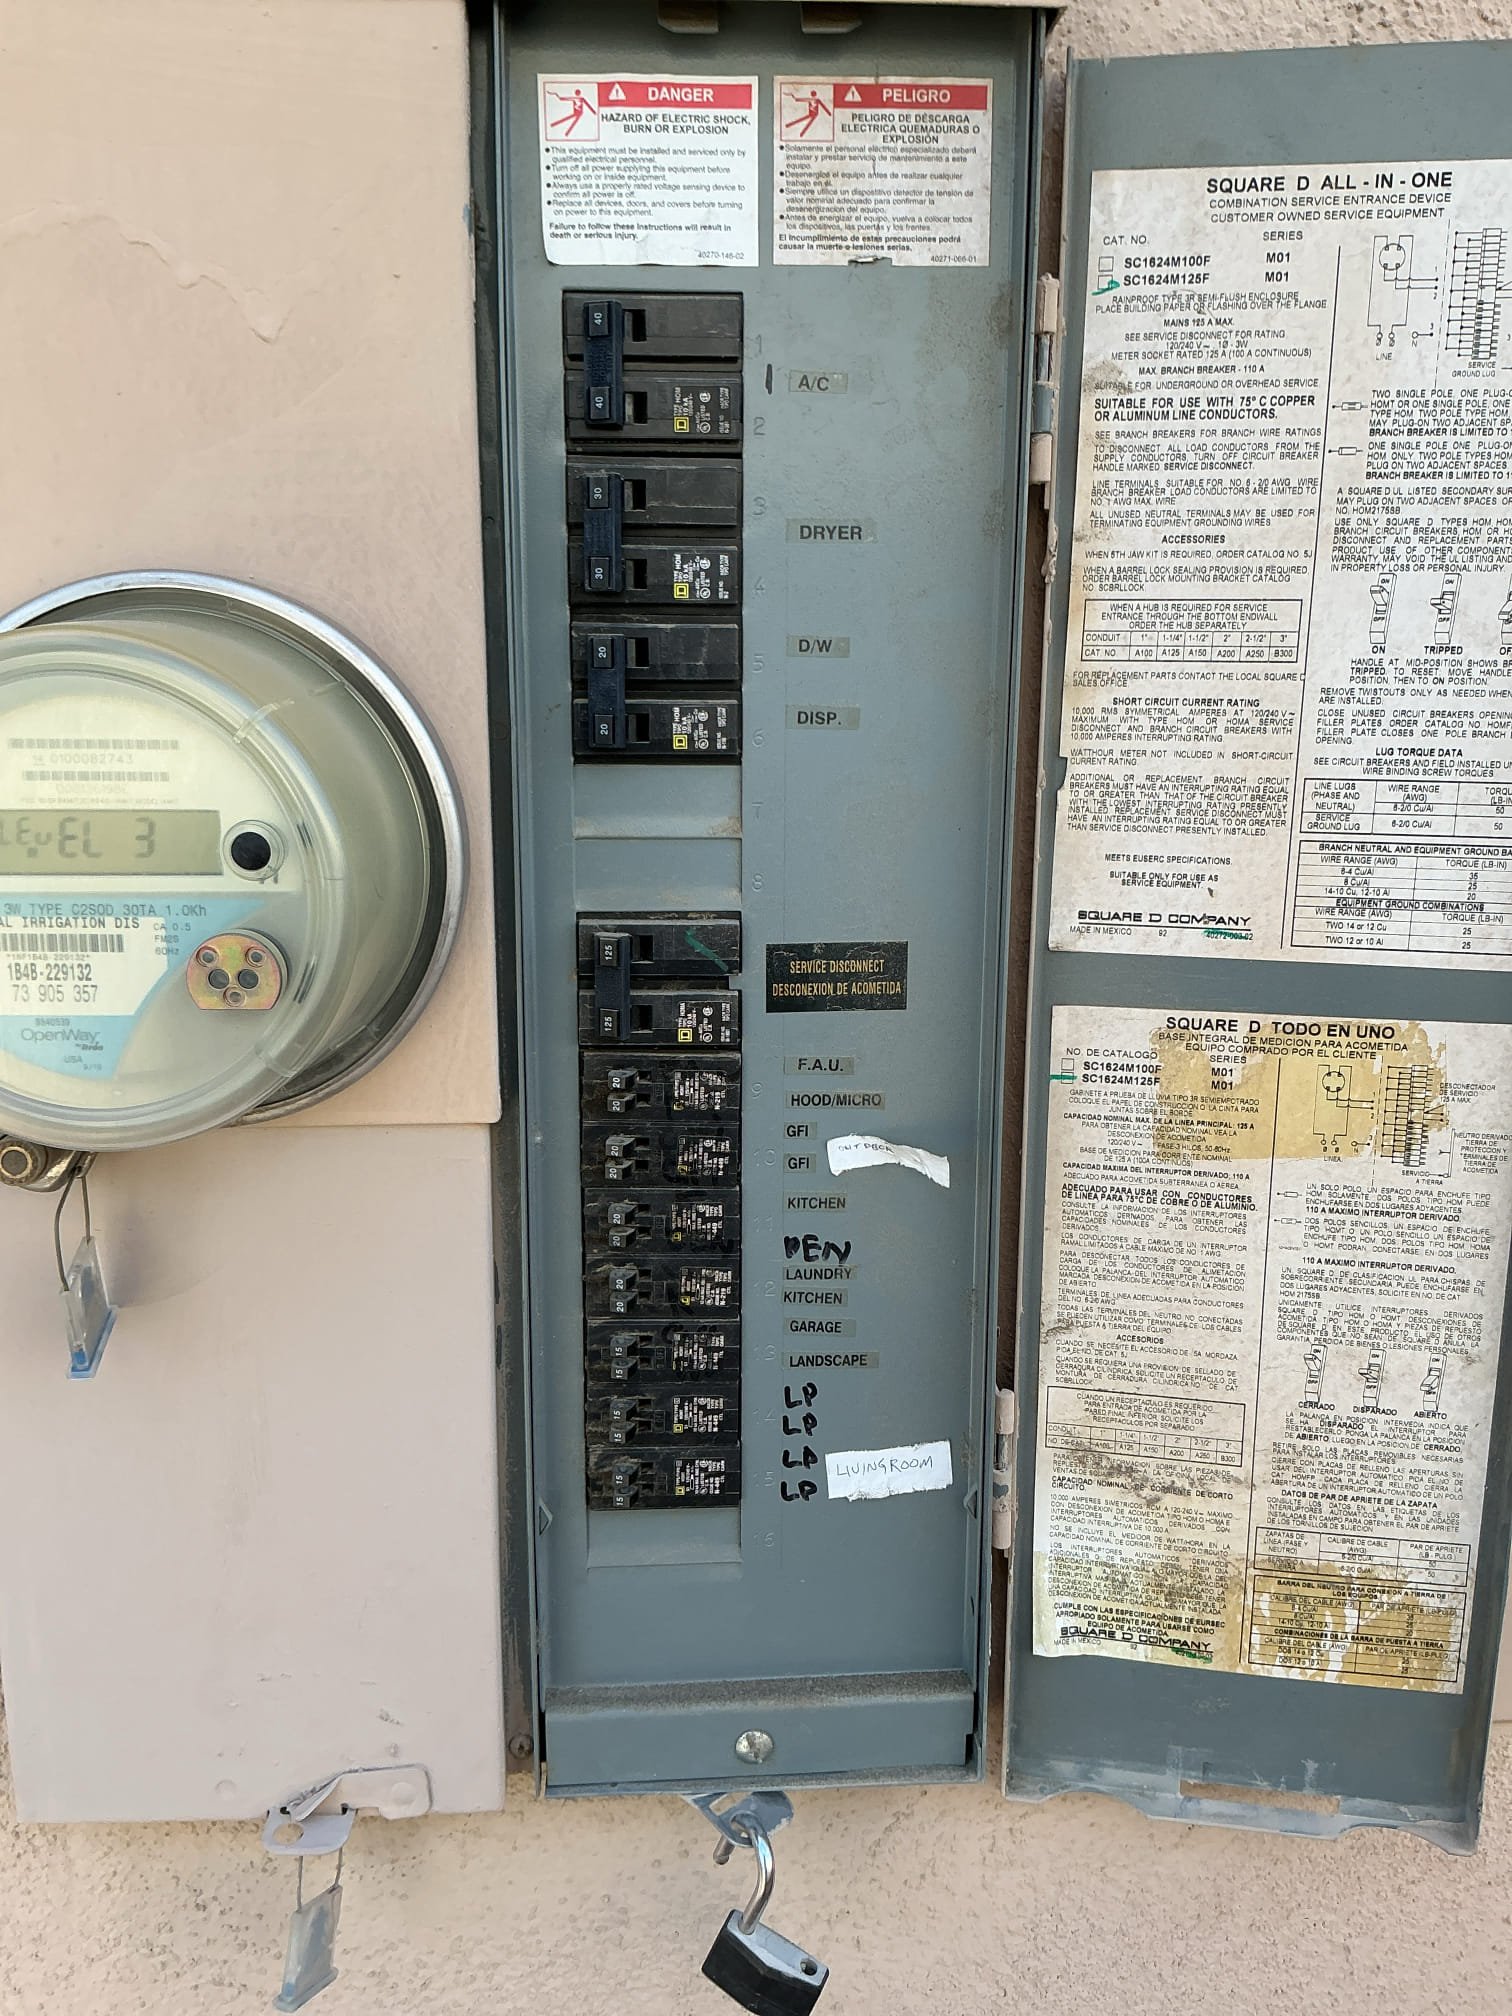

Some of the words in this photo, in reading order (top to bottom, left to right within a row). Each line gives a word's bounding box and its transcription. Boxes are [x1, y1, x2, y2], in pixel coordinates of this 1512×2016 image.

[648, 87, 713, 102] DANGER
[883, 89, 950, 102] PELIGRO
[600, 114, 642, 122] HAZARD
[645, 114, 658, 123] OF
[662, 114, 710, 123] ELECTRIC
[713, 115, 750, 125] SHOCK,
[852, 113, 895, 124] PELIGRO
[898, 113, 911, 123] DE
[624, 124, 651, 133] BURN
[655, 124, 669, 133] OR
[673, 125, 728, 134] EXPLOSION
[842, 124, 897, 135] ELECTRICA
[899, 124, 969, 135] QUEMADURAS
[973, 125, 980, 134] O
[1207, 177, 1285, 193] SQUARE
[1297, 176, 1309, 191] D
[1321, 175, 1356, 190] ALL
[1375, 173, 1393, 188] IN
[1412, 172, 1452, 188] ONE
[1210, 197, 1287, 208] COMBINATION
[1291, 196, 1340, 206] SERVICE
[1344, 194, 1405, 205] ENTRANCE
[1409, 193, 1452, 203] DEVICE
[1211, 212, 1273, 223] CUSTOMER
[1278, 211, 1320, 221] OWNED
[1324, 210, 1373, 220] SERVICE
[1377, 208, 1445, 219] EQUIPMENT
[1131, 235, 1149, 245] NO.
[1263, 231, 1303, 241] SERIES
[1125, 256, 1211, 268] SC1624M100F
[1266, 252, 1290, 263] M01
[1124, 273, 1210, 286] SC1624M125F
[1265, 271, 1288, 282] M01
[594, 312, 602, 325] 40
[796, 375, 829, 392] A/C
[595, 396, 604, 409] 40
[1095, 398, 1146, 409] SUITABLE
[1152, 397, 1173, 408] FOR
[1180, 397, 1200, 408] USE
[1207, 396, 1233, 407] WITH
[1240, 396, 1256, 407] 75°
[1259, 395, 1266, 407] C
[1270, 395, 1315, 406] COPPER
[1095, 411, 1109, 421] OR
[1112, 410, 1169, 421] ALUMINUM
[1173, 409, 1195, 420] LINE
[1199, 408, 1277, 420] CONDUCTORS.
[594, 487, 602, 500] 30
[800, 525, 862, 540] DRYER
[1162, 535, 1225, 544] ACCESSORIES
[594, 567, 603, 580] 30
[598, 646, 607, 658] 20
[799, 639, 832, 653] D/W
[1372, 645, 1385, 654] ON
[1424, 646, 1463, 655] TRIPPED
[1113, 697, 1142, 706] SHORT
[1145, 698, 1179, 706] CIRCUIT
[1182, 698, 1224, 707] CURRENT
[1227, 699, 1260, 707] RATING
[798, 711, 841, 725] DISP.
[600, 723, 609, 735] 20
[1376, 747, 1394, 756] LUG
[1397, 748, 1435, 757] TORQUE
[1438, 748, 1463, 757] DATA
[135, 816, 157, 859] 3
[4, 904, 21, 915] 3W
[29, 904, 62, 915] TYPE
[167, 904, 206, 916] 1.0Kh
[22, 917, 106, 928] IRRIGATION
[114, 918, 140, 928] DIS
[1078, 911, 1142, 923] SQUARE
[1149, 913, 1162, 923] D
[1168, 914, 1251, 926] COMPANY
[1070, 926, 1091, 934] MADE
[1103, 927, 1132, 935] MEXICO
[8, 963, 92, 981] 1B4B-229132
[790, 960, 827, 973] SERVICE
[830, 960, 884, 973] DISCONNECT
[12, 984, 29, 1002] 73
[39, 984, 64, 1002] 905
[73, 984, 98, 1002] 357
[773, 983, 833, 996] DESCONEXION
[837, 982, 848, 995] DE
[851, 981, 902, 995] ACOMETIDA
[604, 1017, 612, 1031] 125
[1166, 1018, 1238, 1032] SQUARE
[1247, 1020, 1260, 1033] D
[1272, 1022, 1321, 1036] TODO
[1327, 1024, 1351, 1037] EN
[1357, 1024, 1395, 1039] UNO
[21, 1026, 100, 1044] OpenWay
[798, 1058, 843, 1071] F.A.U.
[1209, 1055, 1247, 1063] SERIES
[1083, 1062, 1162, 1073] SC1624M100F
[1212, 1067, 1235, 1079] M01
[613, 1078, 620, 1088] 20
[1082, 1075, 1160, 1086] SC1624M125F
[1211, 1080, 1233, 1090] M01
[613, 1101, 620, 1111] 20
[791, 1094, 881, 1106] HOOD/MICRO
[785, 1125, 808, 1137] GFI
[611, 1146, 618, 1156] 20
[788, 1157, 809, 1169] GFI
[610, 1168, 616, 1178] 20
[788, 1197, 845, 1209] KITCHEN
[614, 1214, 621, 1224] 20
[613, 1236, 621, 1246] 20
[786, 1268, 851, 1280] LAUNDRY
[617, 1279, 623, 1289] 20
[782, 1291, 842, 1304] KITCHEN
[617, 1302, 624, 1312] 20
[790, 1321, 842, 1333] GARAGE
[1114, 1335, 1164, 1344] ACCESORIOS
[616, 1348, 622, 1356] 15
[790, 1355, 867, 1367] LANDSCAPE
[616, 1370, 623, 1378] 15
[784, 1382, 818, 1408] LP
[1296, 1401, 1335, 1411] CERRADO
[1353, 1405, 1397, 1416] DISPARADO
[614, 1411, 620, 1419] 15
[1414, 1409, 1447, 1419] ABIERTO
[782, 1414, 818, 1436] LP
[615, 1433, 621, 1441] 15
[782, 1446, 818, 1469] LP
[616, 1475, 623, 1484] 15
[780, 1480, 818, 1502] LP
[617, 1497, 623, 1505] 15
